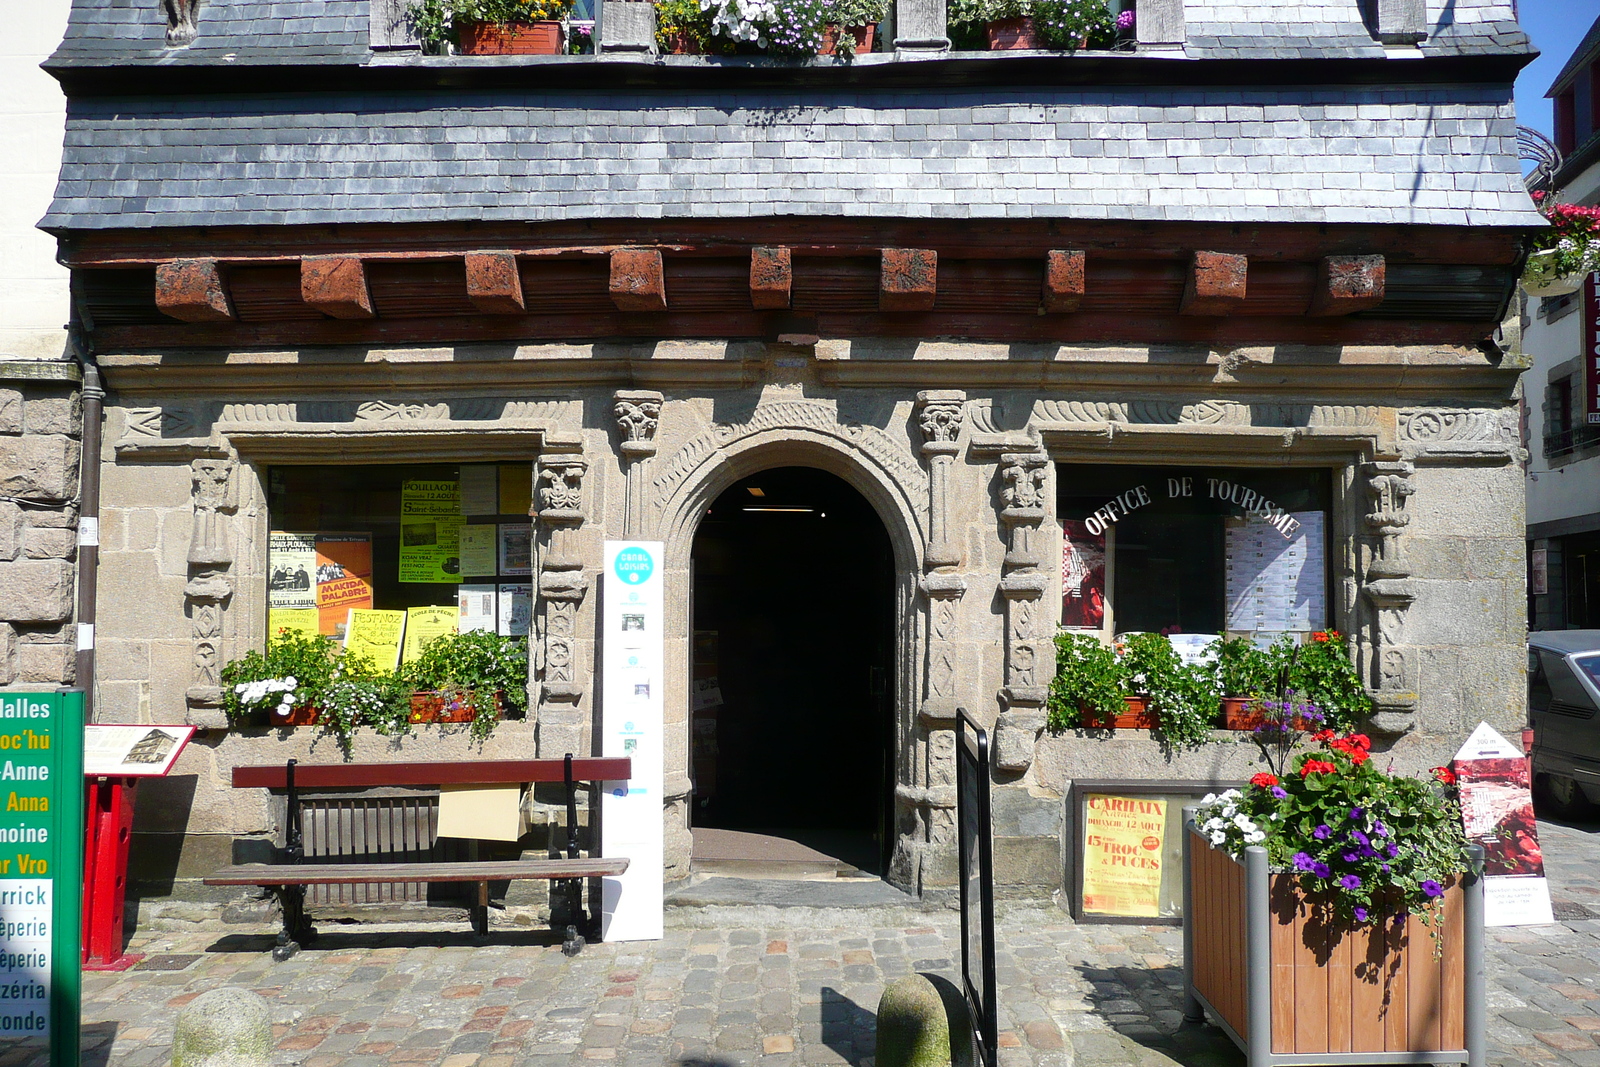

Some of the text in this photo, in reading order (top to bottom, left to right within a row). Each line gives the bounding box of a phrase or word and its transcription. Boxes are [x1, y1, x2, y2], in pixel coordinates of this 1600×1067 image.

[1085, 477, 1301, 539] OFFICE DE TOURISME
[321, 580, 364, 594] MAKIDA
[321, 587, 368, 602] PALABRE
[6, 791, 48, 812] Anna
[1089, 797, 1162, 816] CARHAIX
[1127, 820, 1137, 829] 12
[1088, 835, 1102, 847] 15
[1102, 842, 1142, 856] TROC
[17, 853, 47, 875] Vro
[1112, 855, 1160, 870] PUCES
[0, 1010, 45, 1030] onde
